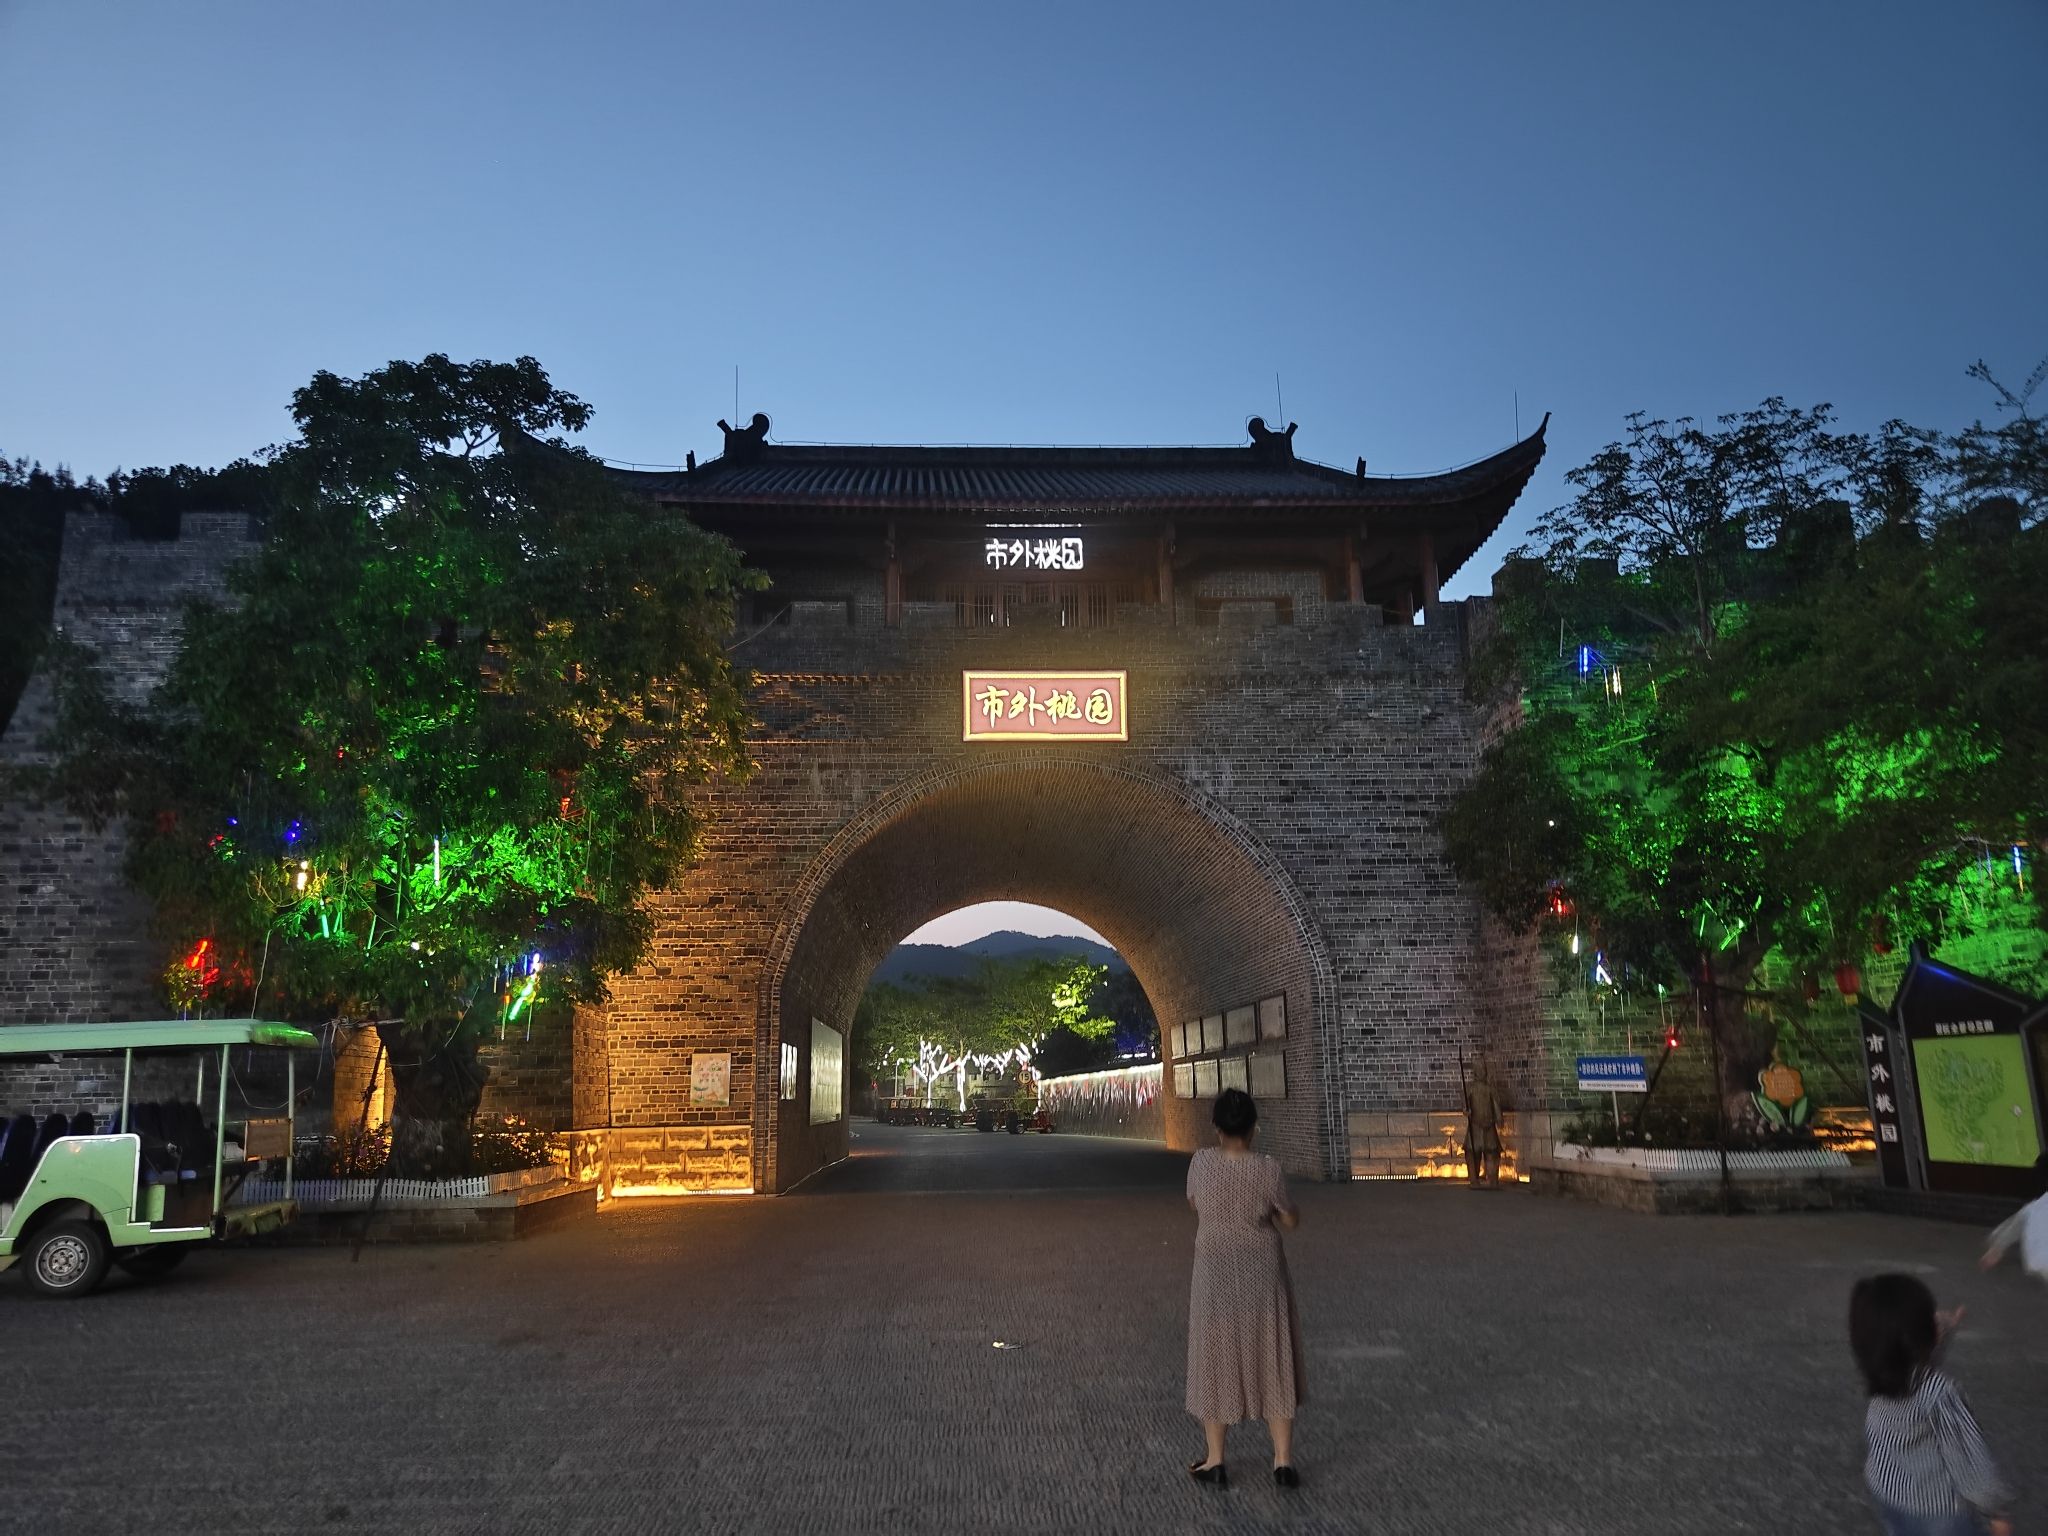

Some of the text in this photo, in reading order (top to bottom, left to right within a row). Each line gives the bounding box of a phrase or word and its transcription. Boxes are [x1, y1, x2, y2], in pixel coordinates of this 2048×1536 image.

[986, 537, 1083, 569] 市外桃园
[975, 684, 1113, 728] 市外桃园
[1866, 1033, 1898, 1142] 市外桃园
